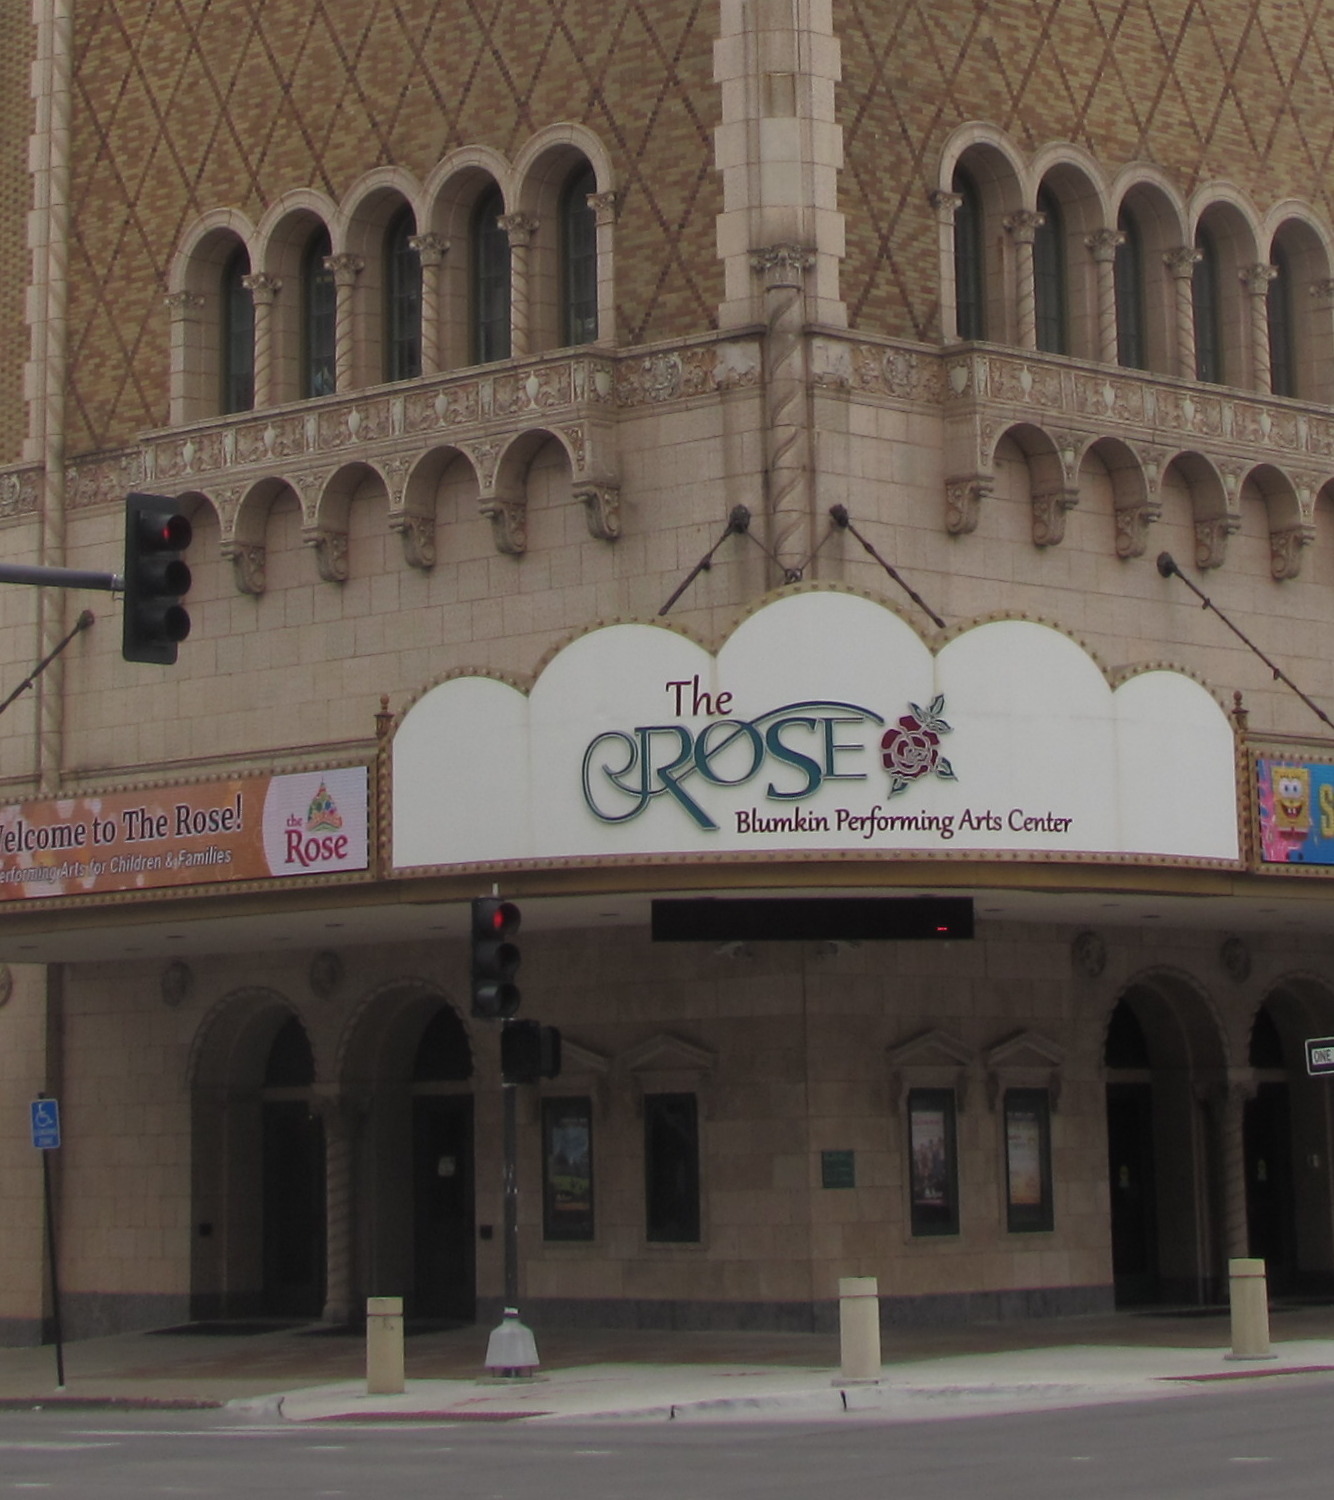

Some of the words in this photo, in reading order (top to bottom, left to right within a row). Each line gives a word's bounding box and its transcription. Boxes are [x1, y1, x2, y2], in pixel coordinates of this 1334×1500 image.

[665, 674, 733, 718] The
[581, 700, 886, 832] ROSE
[92, 816, 116, 844] to
[123, 807, 168, 841] The
[175, 792, 243, 837] Rose!
[287, 813, 302, 827] the
[735, 807, 830, 834] Blumkin
[835, 805, 955, 839] Performing
[958, 808, 1003, 831] Arts
[1007, 809, 1073, 833] Center
[60, 861, 85, 878] Arts
[90, 858, 106, 875] for
[110, 853, 161, 873] Children
[165, 853, 176, 866] &
[178, 848, 232, 867] Families
[284, 829, 348, 867] Rose
[1314, 1049, 1331, 1063] ONE
